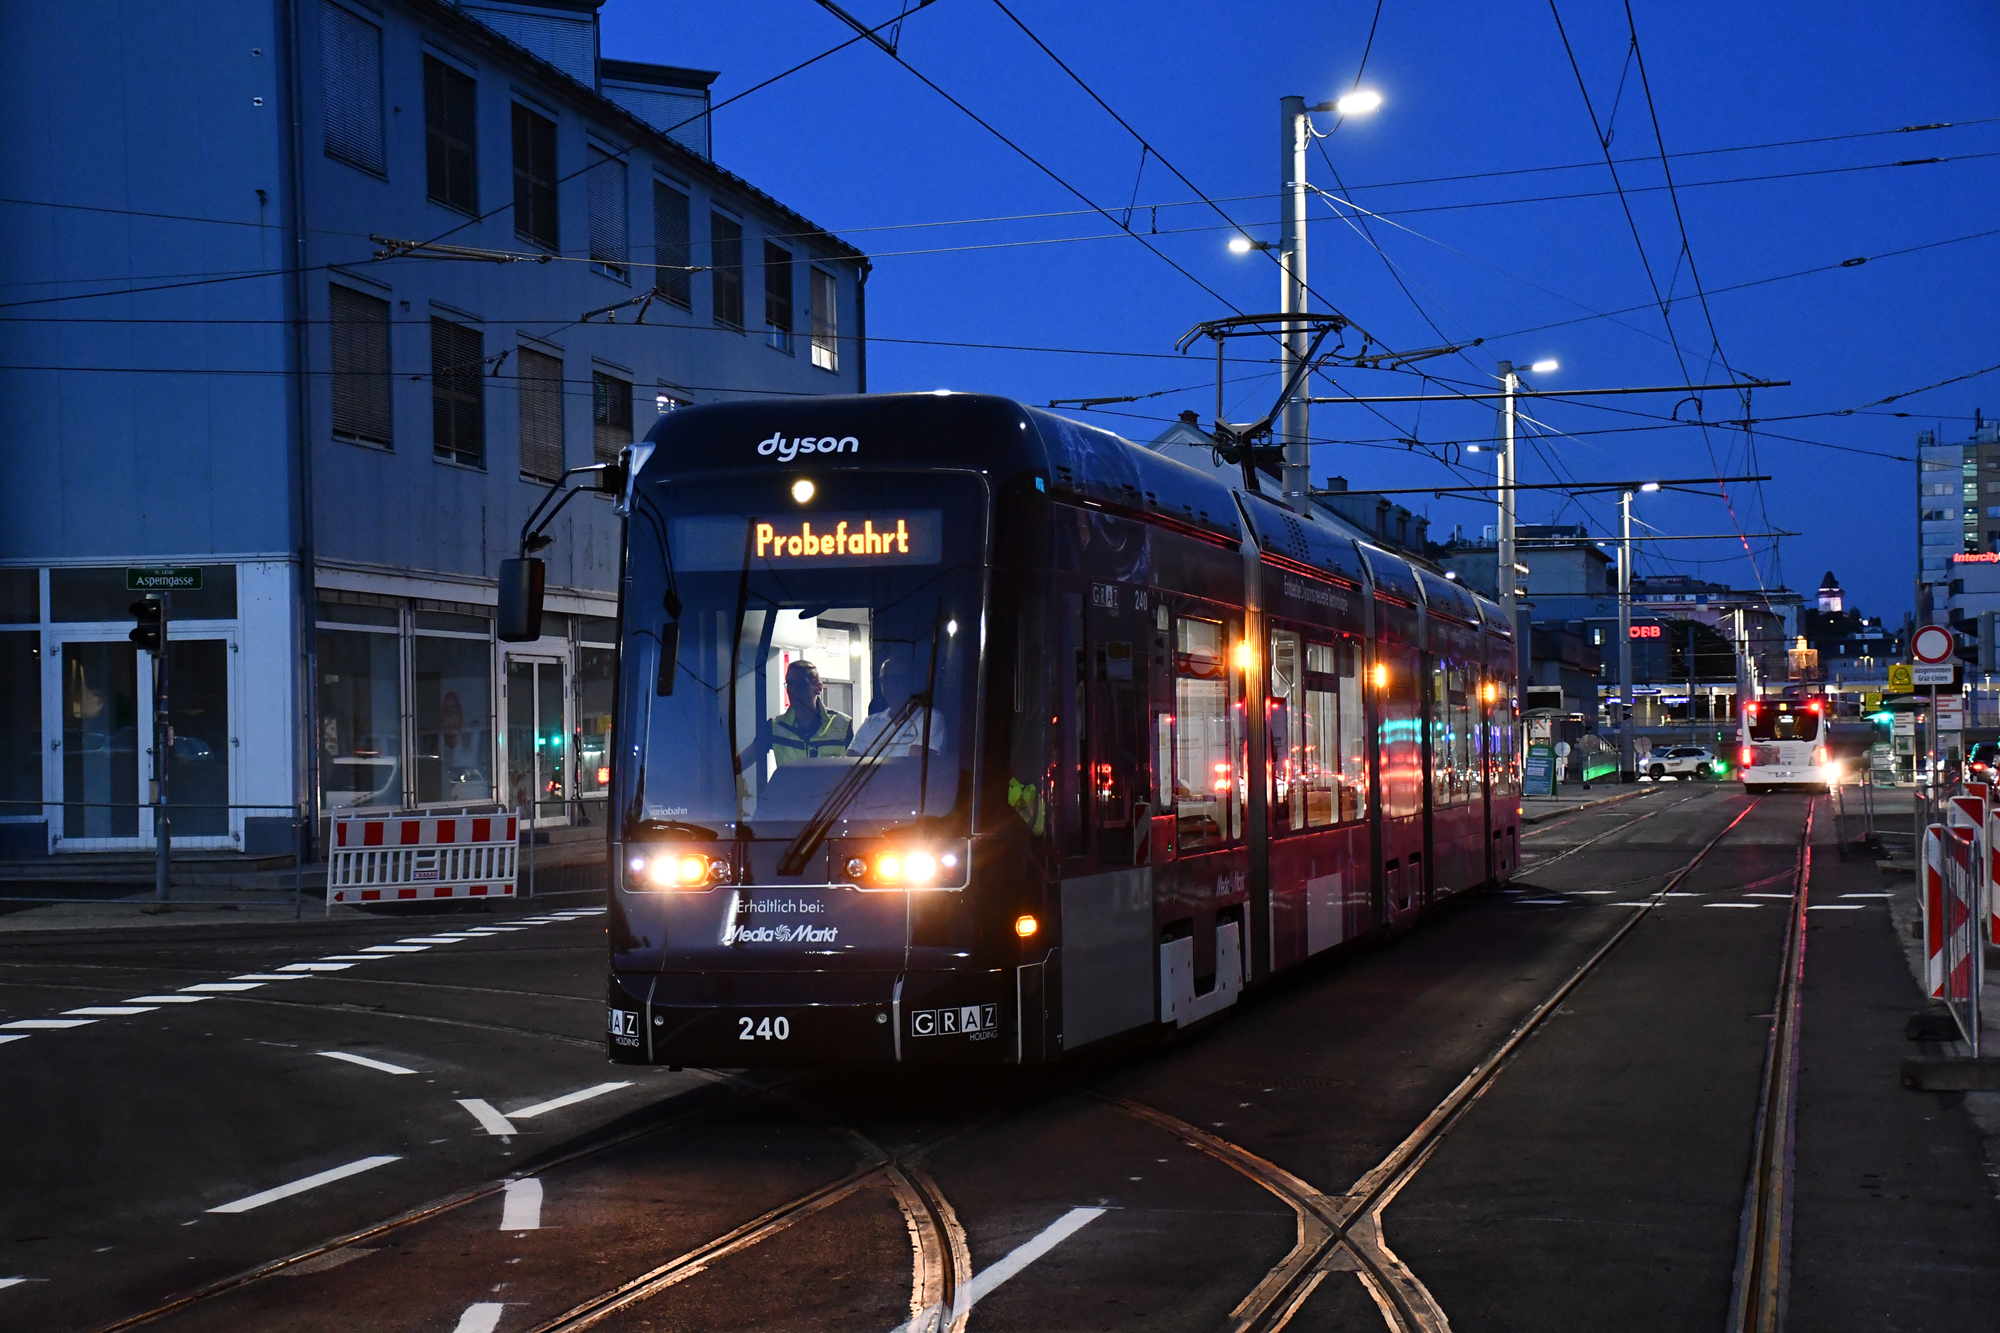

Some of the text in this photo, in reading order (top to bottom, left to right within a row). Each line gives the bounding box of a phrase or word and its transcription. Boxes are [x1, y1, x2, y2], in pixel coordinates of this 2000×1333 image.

[757, 432, 859, 462] dyson
[756, 519, 909, 557] Probefahrt
[136, 576, 193, 587] Asperngasse
[1093, 585, 1118, 606] GRAZ
[1135, 590, 1148, 611] 240
[1918, 674, 1948, 682] Graz-Linien
[650, 806, 688, 816] variobahn
[737, 899, 824, 913] Erhältlich bei:
[738, 1016, 790, 1040] 240
[914, 1006, 996, 1034] GRAZ
[969, 1030, 998, 1042] HOLDING
